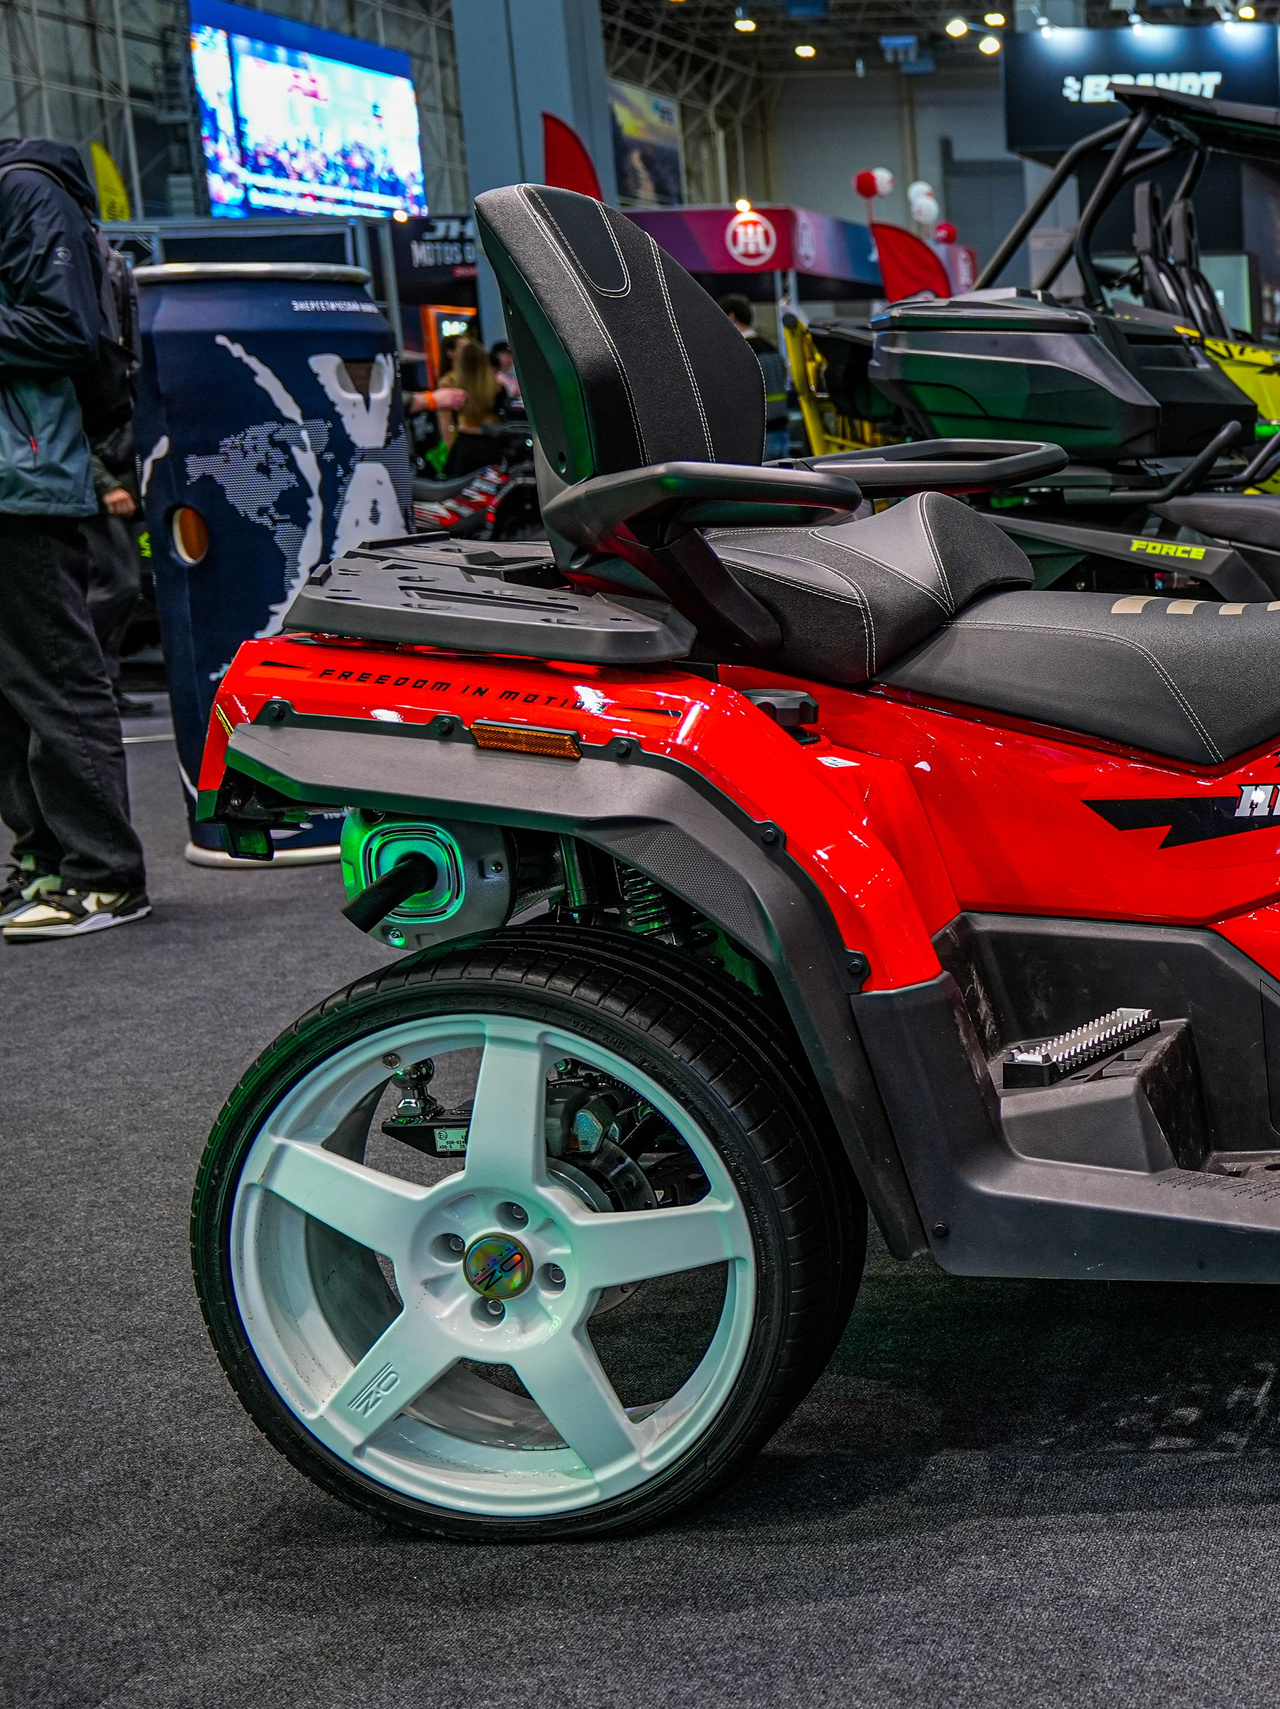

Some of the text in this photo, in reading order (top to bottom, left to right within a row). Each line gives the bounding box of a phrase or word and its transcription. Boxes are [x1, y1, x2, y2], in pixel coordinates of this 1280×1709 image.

[1131, 540, 1206, 560] FORCE
[318, 669, 452, 692] FREEDOM
[461, 685, 489, 697] IN
